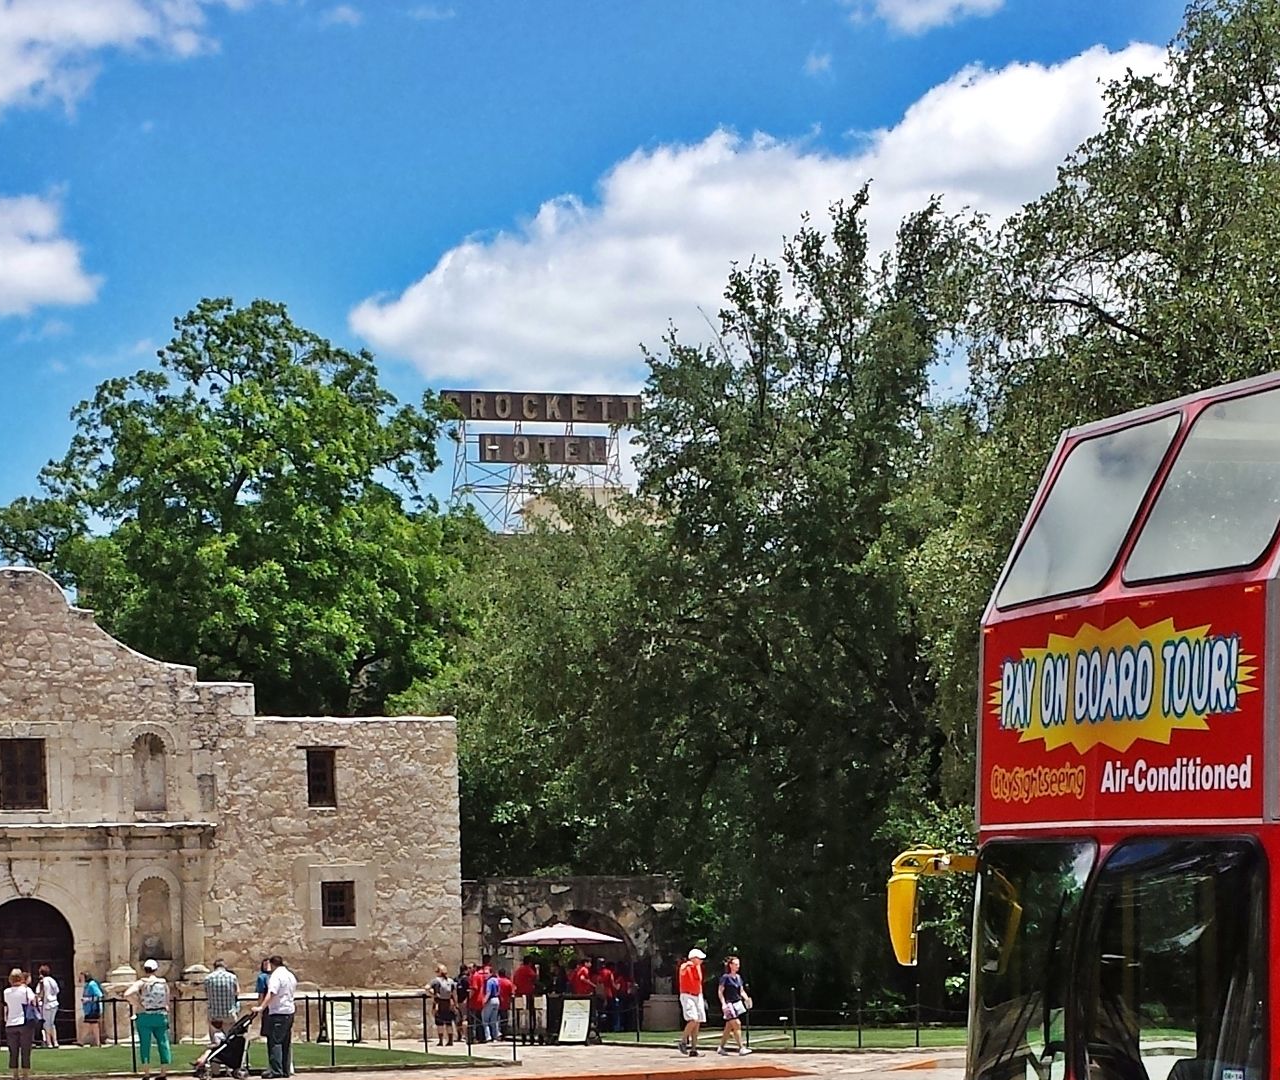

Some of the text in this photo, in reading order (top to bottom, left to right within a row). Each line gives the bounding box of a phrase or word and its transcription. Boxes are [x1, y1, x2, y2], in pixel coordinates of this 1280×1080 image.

[484, 435, 606, 463] HOTEL
[1000, 634, 1239, 729] PAY ON BOARD TOUR!
[1100, 754, 1253, 794] Air-Conditioned
